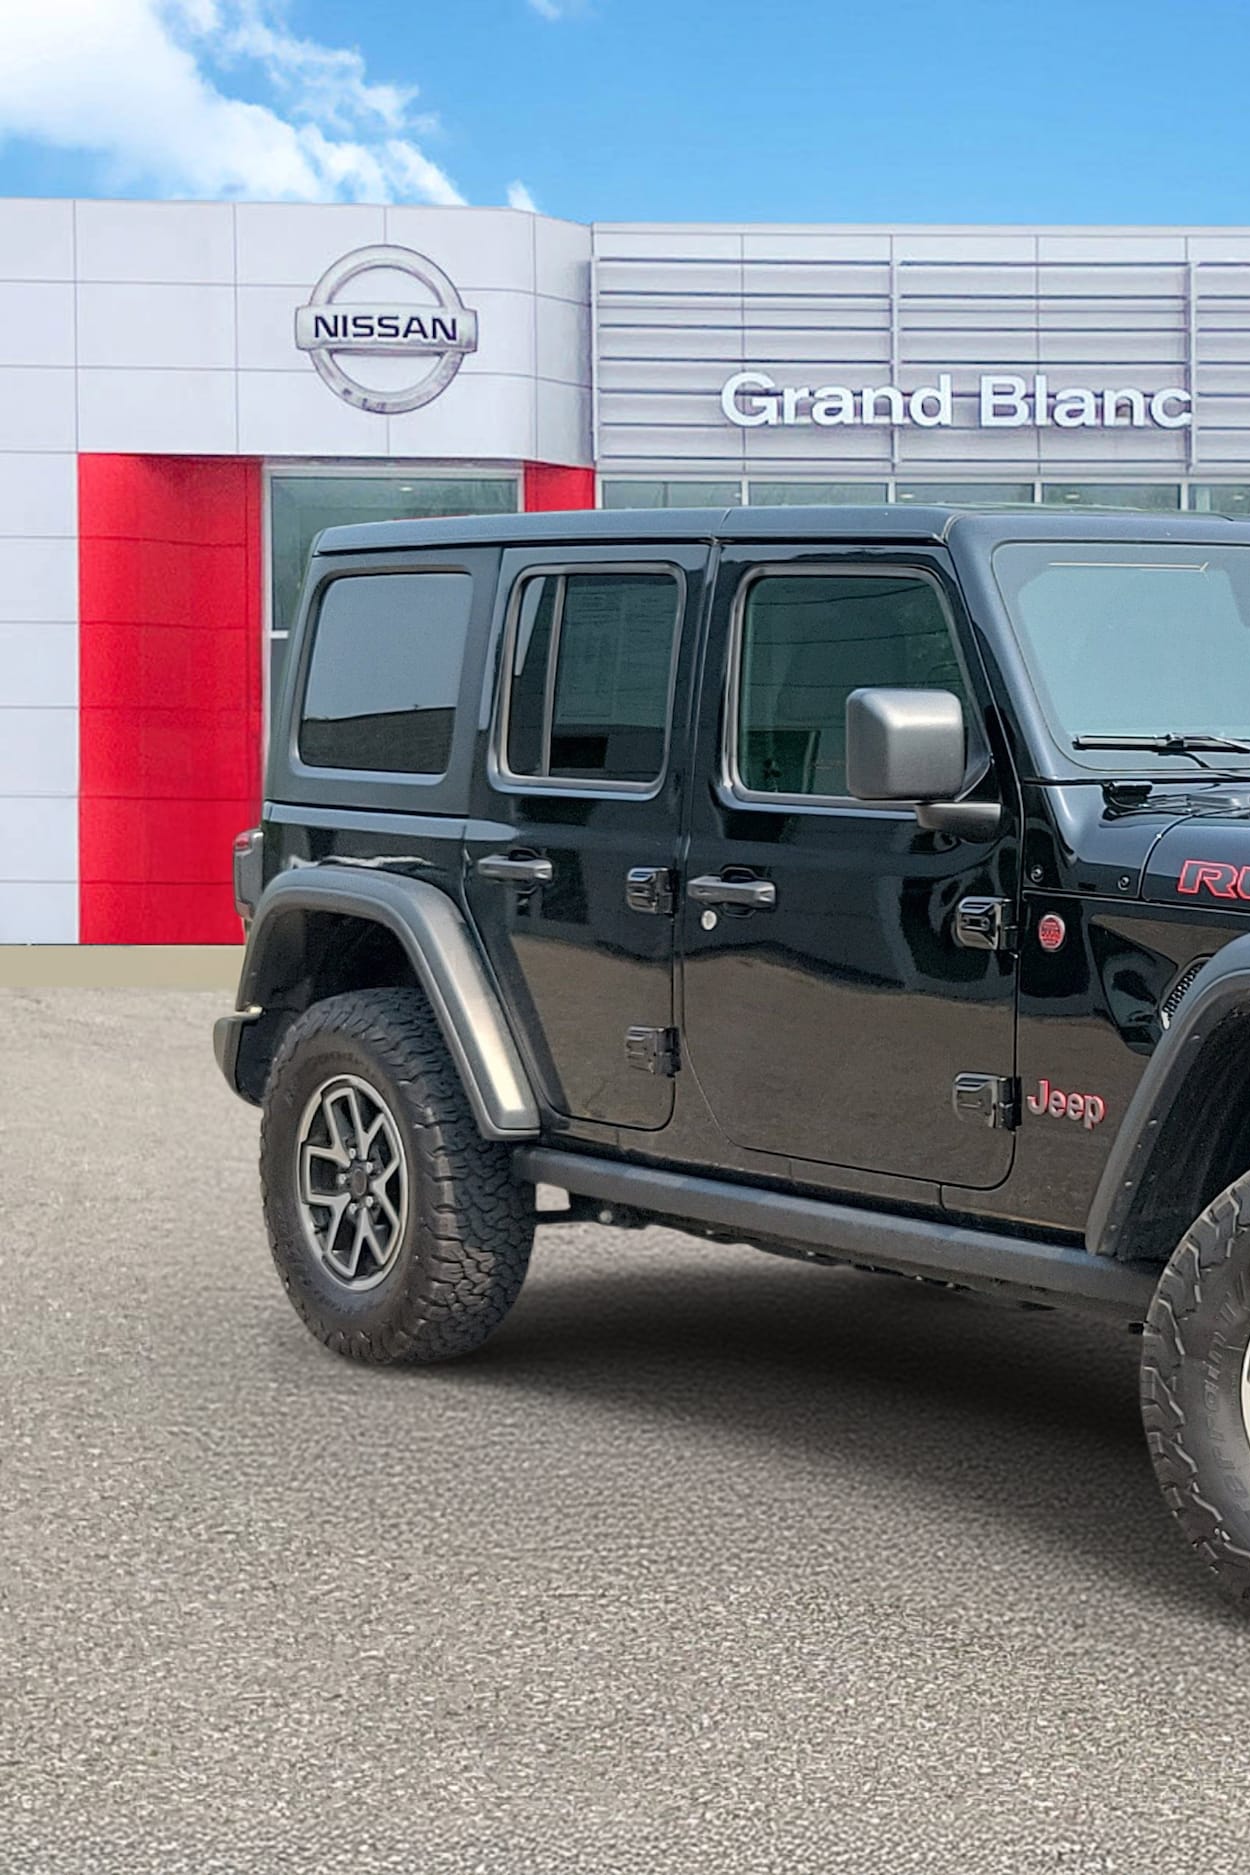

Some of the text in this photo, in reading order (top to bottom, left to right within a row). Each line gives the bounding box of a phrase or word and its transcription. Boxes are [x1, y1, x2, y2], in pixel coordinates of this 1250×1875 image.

[313, 314, 457, 341] NISSAN
[720, 370, 1193, 428] Grand Blanc
[1026, 1078, 1106, 1131] Jeep
